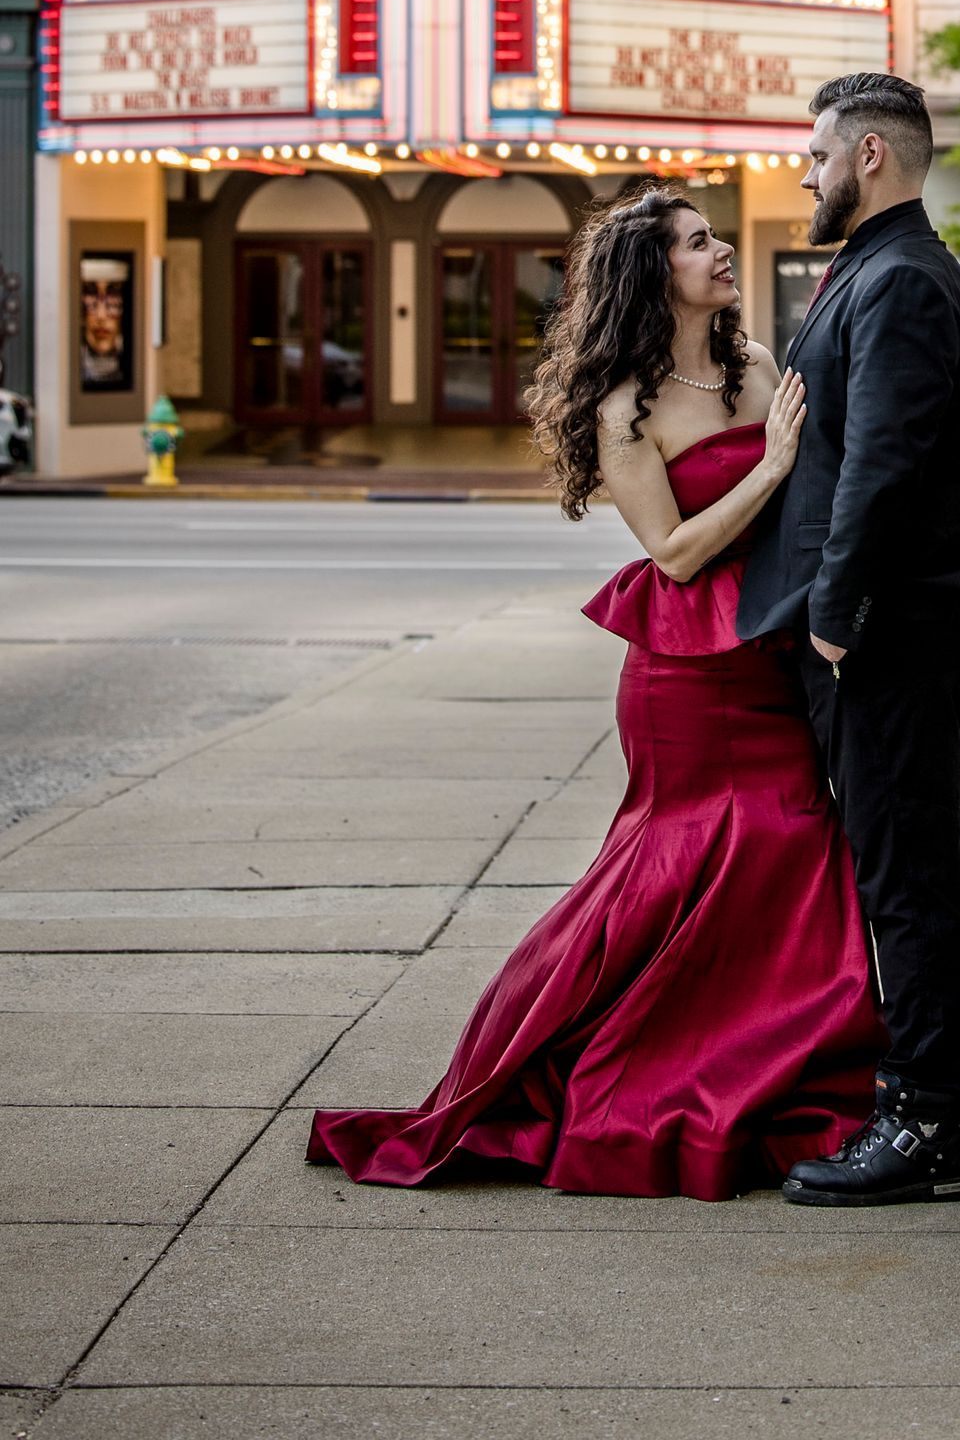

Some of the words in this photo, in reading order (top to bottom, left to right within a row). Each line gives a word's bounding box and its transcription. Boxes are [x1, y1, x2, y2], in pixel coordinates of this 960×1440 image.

[224, 46, 258, 65] WORLD
[757, 56, 789, 74] MUCH
[611, 68, 644, 88] FROM
[757, 77, 795, 96] WORLD
[662, 93, 746, 113] CHALLENGERS
